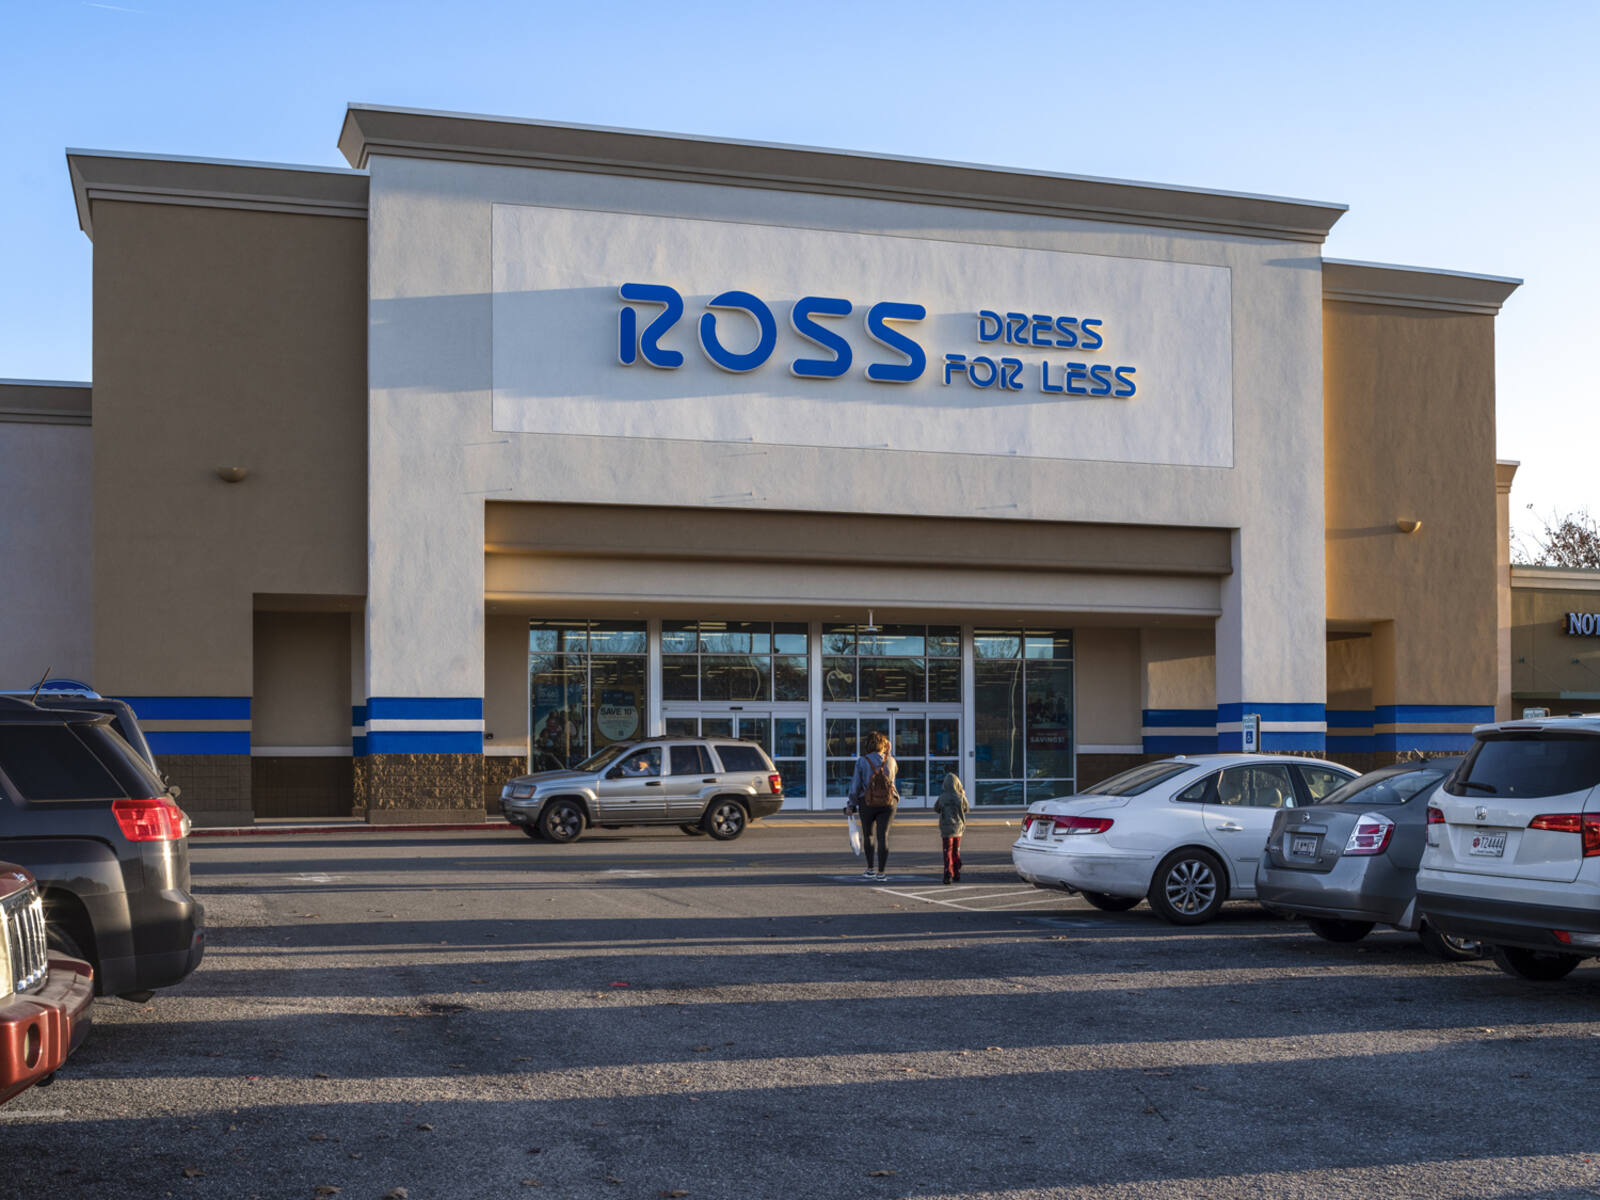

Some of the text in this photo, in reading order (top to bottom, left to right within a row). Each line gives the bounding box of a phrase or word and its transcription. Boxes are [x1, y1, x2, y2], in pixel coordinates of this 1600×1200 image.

[618, 282, 927, 384] ROSS
[977, 309, 1103, 351] DRESS
[943, 353, 1137, 399] FOR LESS
